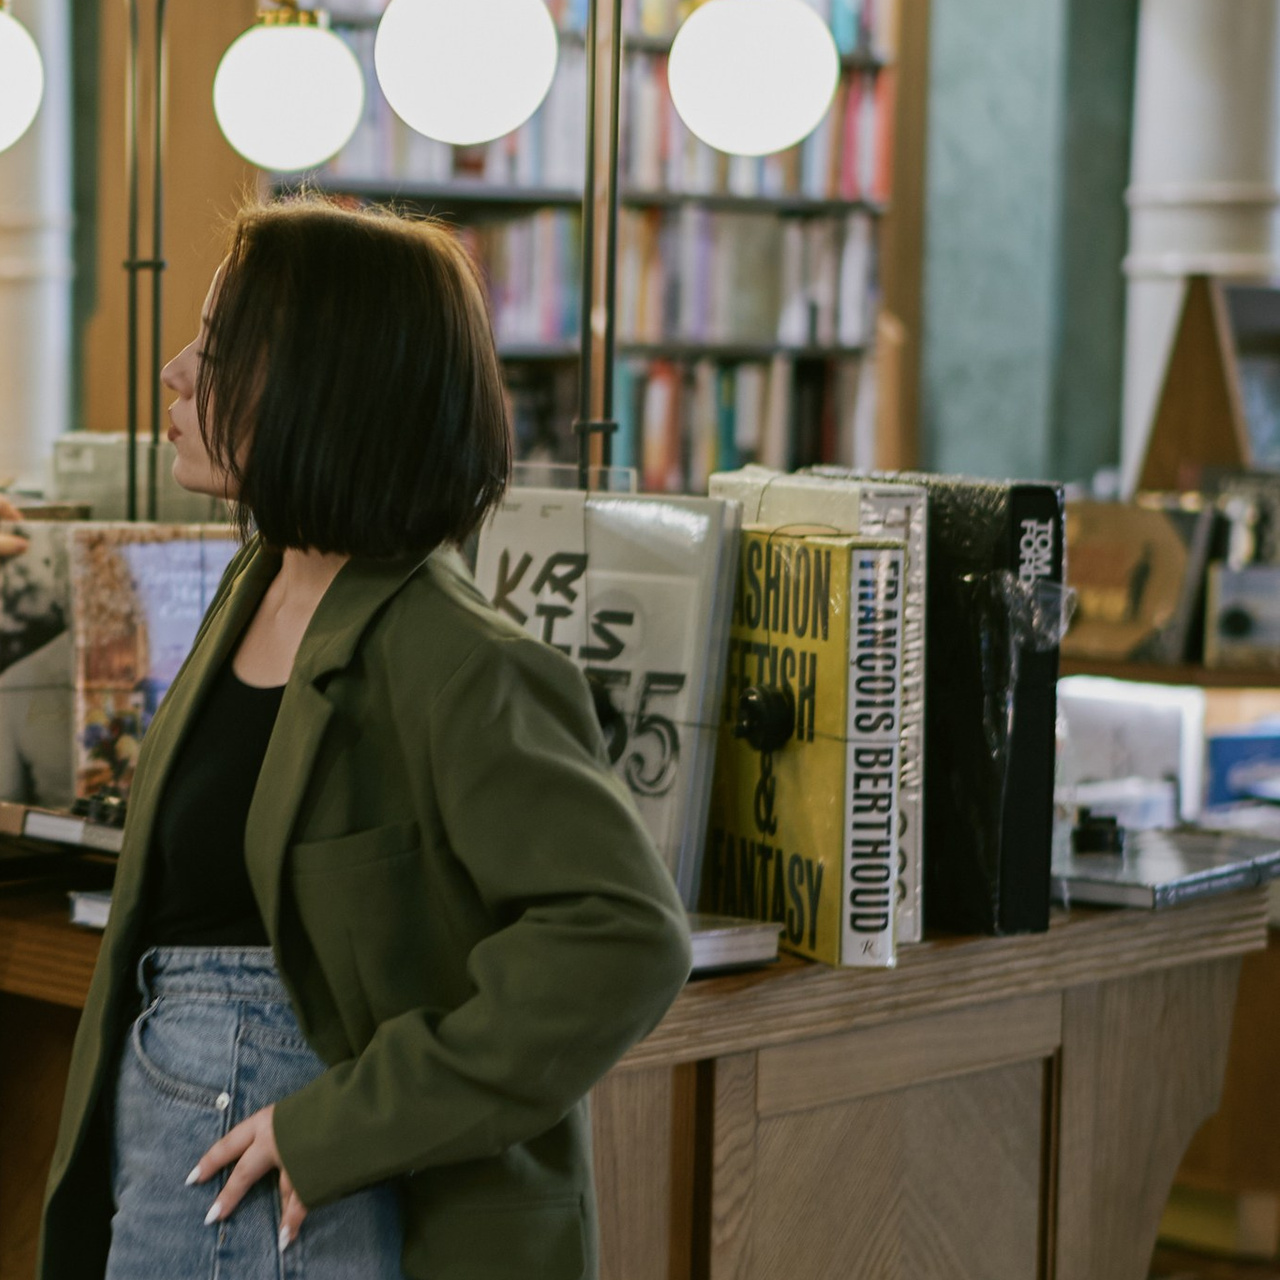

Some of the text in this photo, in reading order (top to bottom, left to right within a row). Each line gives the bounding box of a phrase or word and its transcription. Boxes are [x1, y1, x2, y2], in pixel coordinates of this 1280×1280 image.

[733, 539, 831, 642] SHION
[1019, 519, 1038, 585] FORD
[1035, 517, 1053, 576] TOM
[850, 559, 900, 735] FRANÇOIS
[753, 748, 778, 837] &
[848, 746, 894, 934] BERTHOUD
